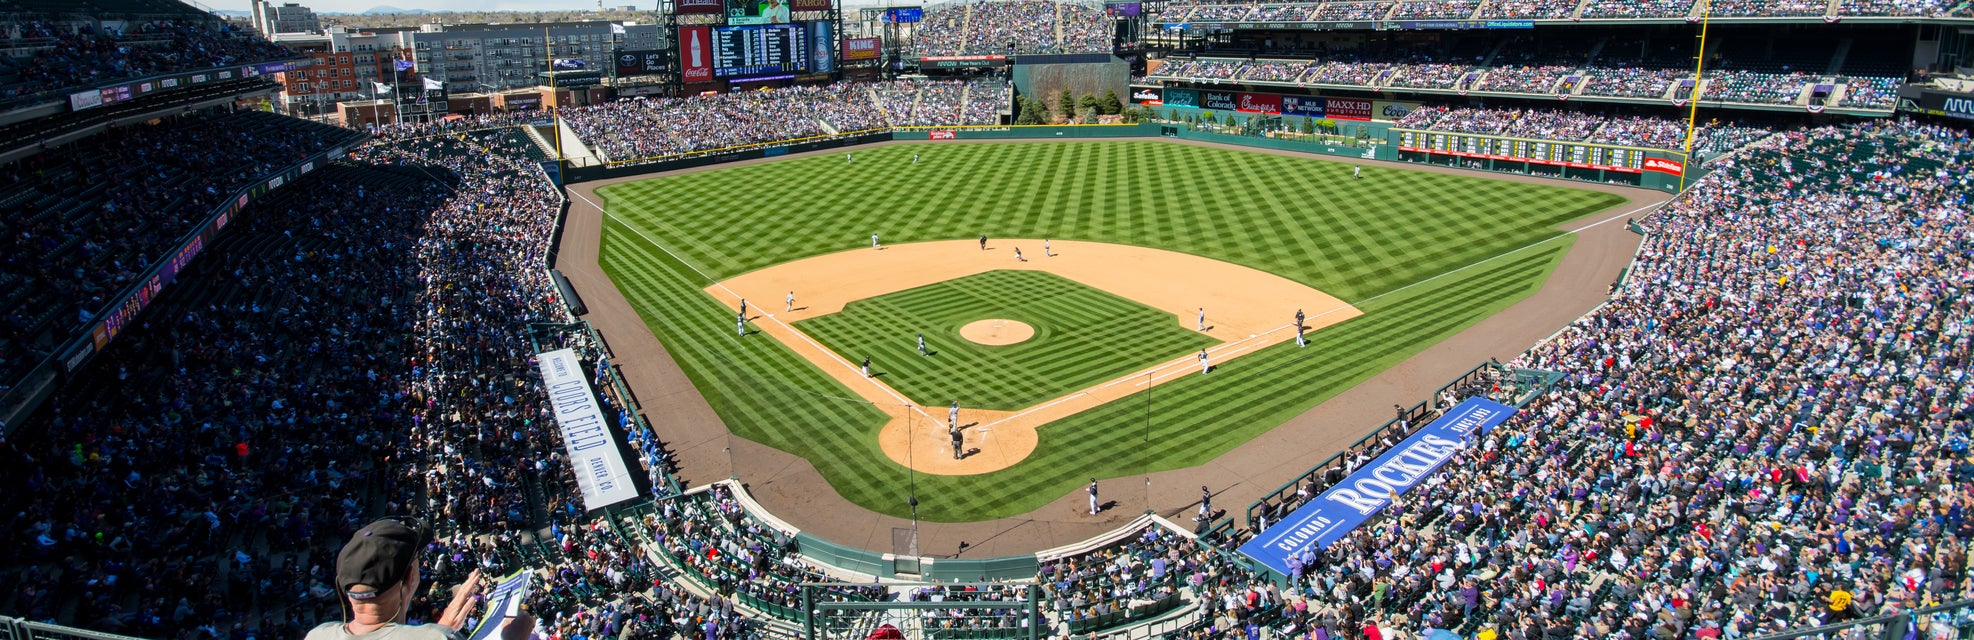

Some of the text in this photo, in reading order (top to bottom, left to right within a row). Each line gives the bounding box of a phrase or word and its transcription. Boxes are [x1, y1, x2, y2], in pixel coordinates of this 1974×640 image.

[849, 40, 874, 50] KING
[1134, 92, 1159, 100] Safelite
[1207, 100, 1236, 109] Colorado
[1327, 100, 1371, 110] MAXX HD
[552, 380, 607, 451] COORS FIELD
[1451, 408, 1491, 433] SINCE 1993
[590, 457, 613, 493] DENVER, CO.
[1326, 433, 1460, 515] ROCKIES
[1277, 516, 1332, 552] COLORADO
